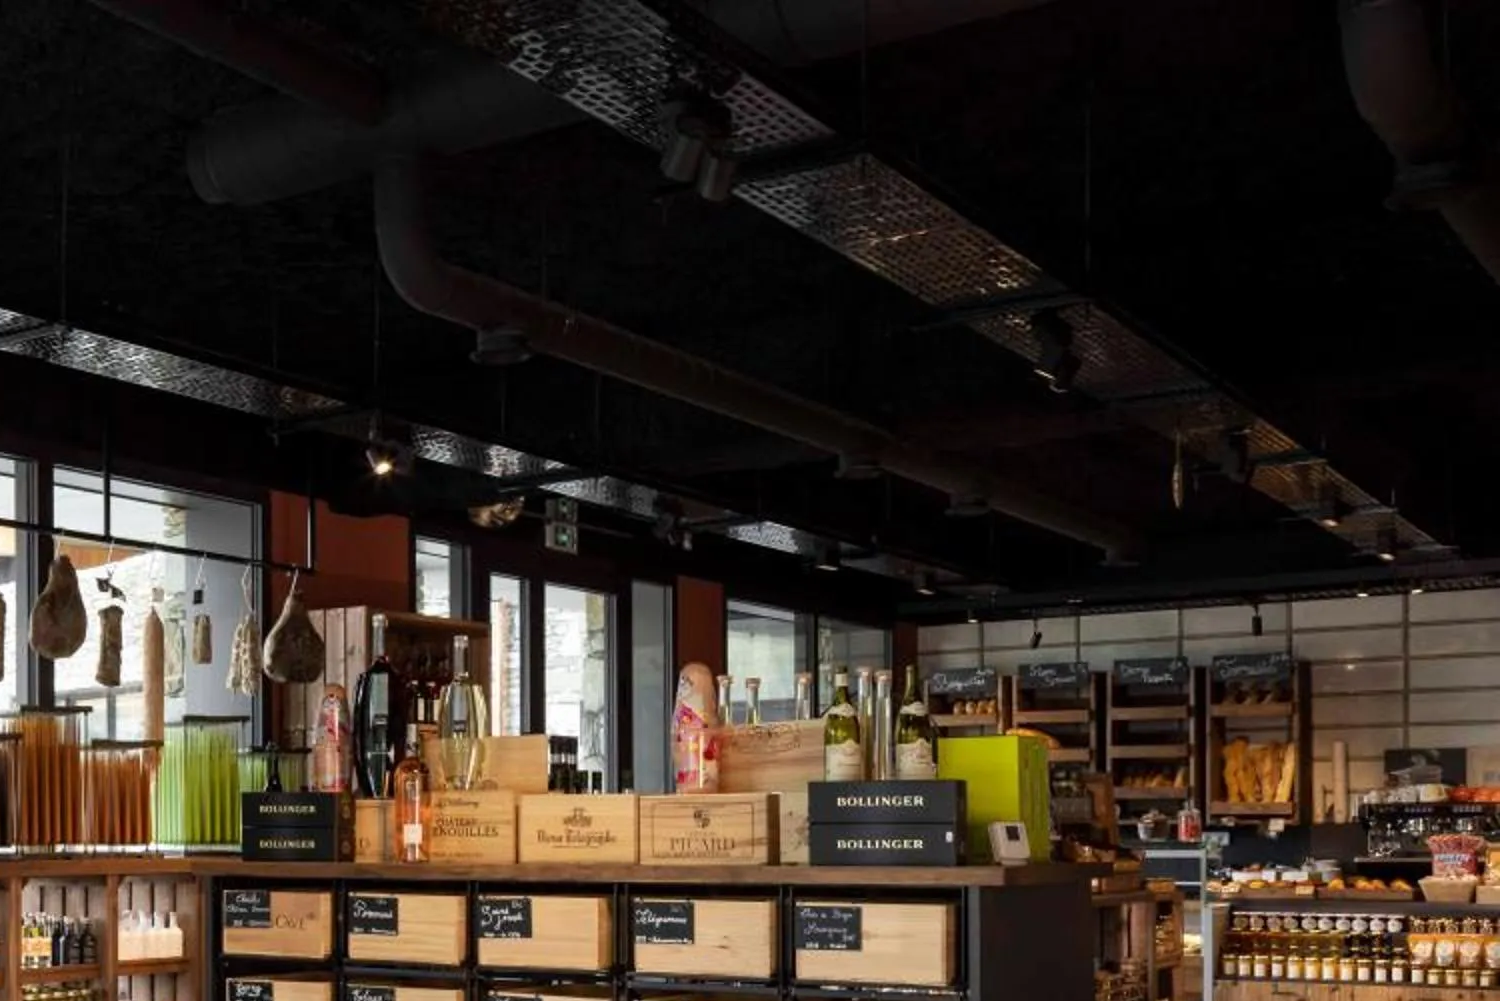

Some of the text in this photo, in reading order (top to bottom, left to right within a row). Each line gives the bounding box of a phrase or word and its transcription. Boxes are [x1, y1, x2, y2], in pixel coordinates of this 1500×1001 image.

[836, 795, 924, 807] BOLLINGER
[669, 837, 736, 851] PICARD
[836, 839, 924, 850] BOLLINGER
